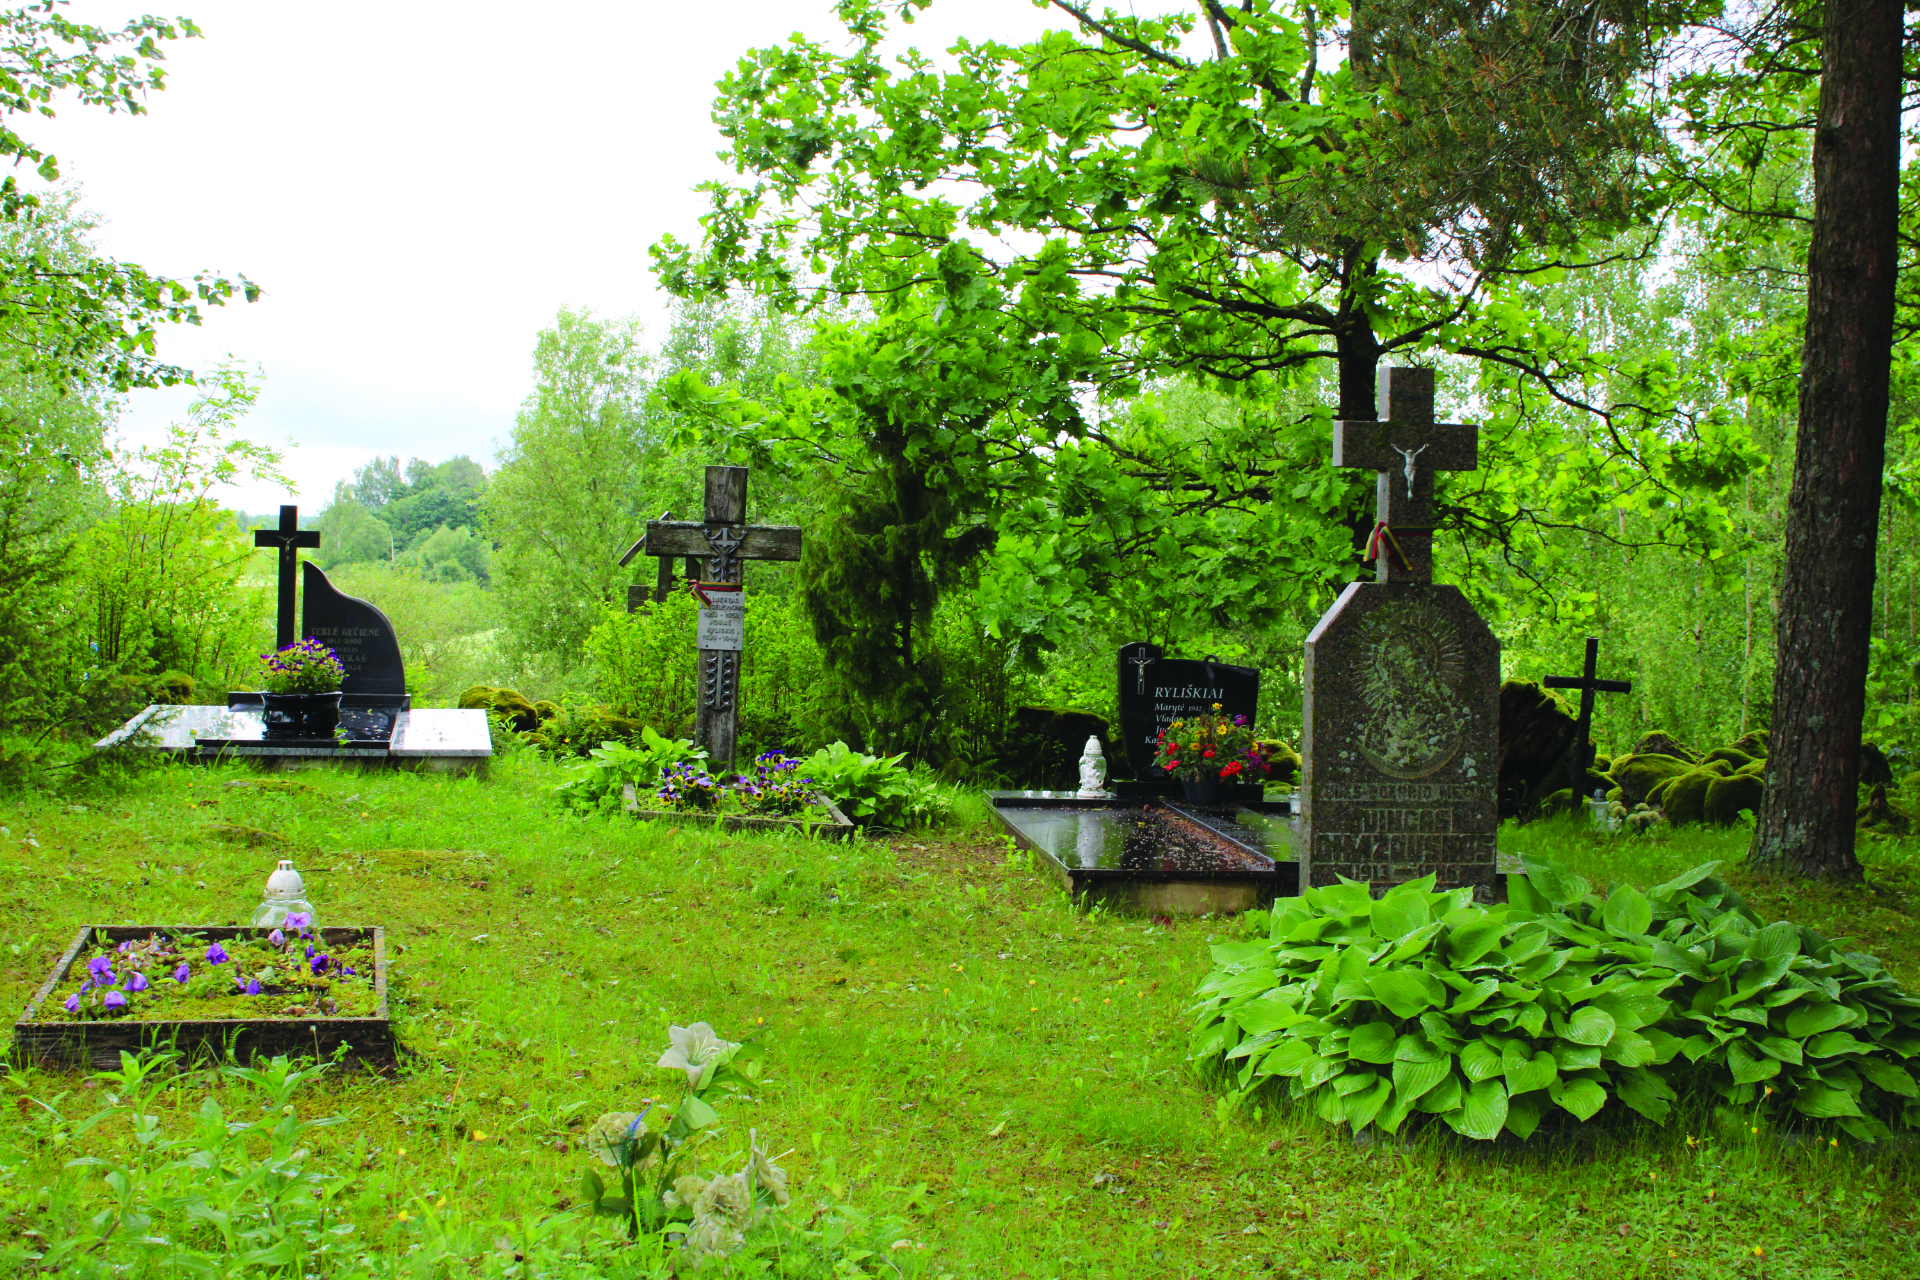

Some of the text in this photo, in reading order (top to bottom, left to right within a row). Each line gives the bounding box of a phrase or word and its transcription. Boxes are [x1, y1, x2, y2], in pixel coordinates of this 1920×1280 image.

[1154, 683, 1224, 699] RYLIŠKIAI
[1154, 702, 1185, 714] Marytė
[1155, 713, 1180, 722] Vlada
